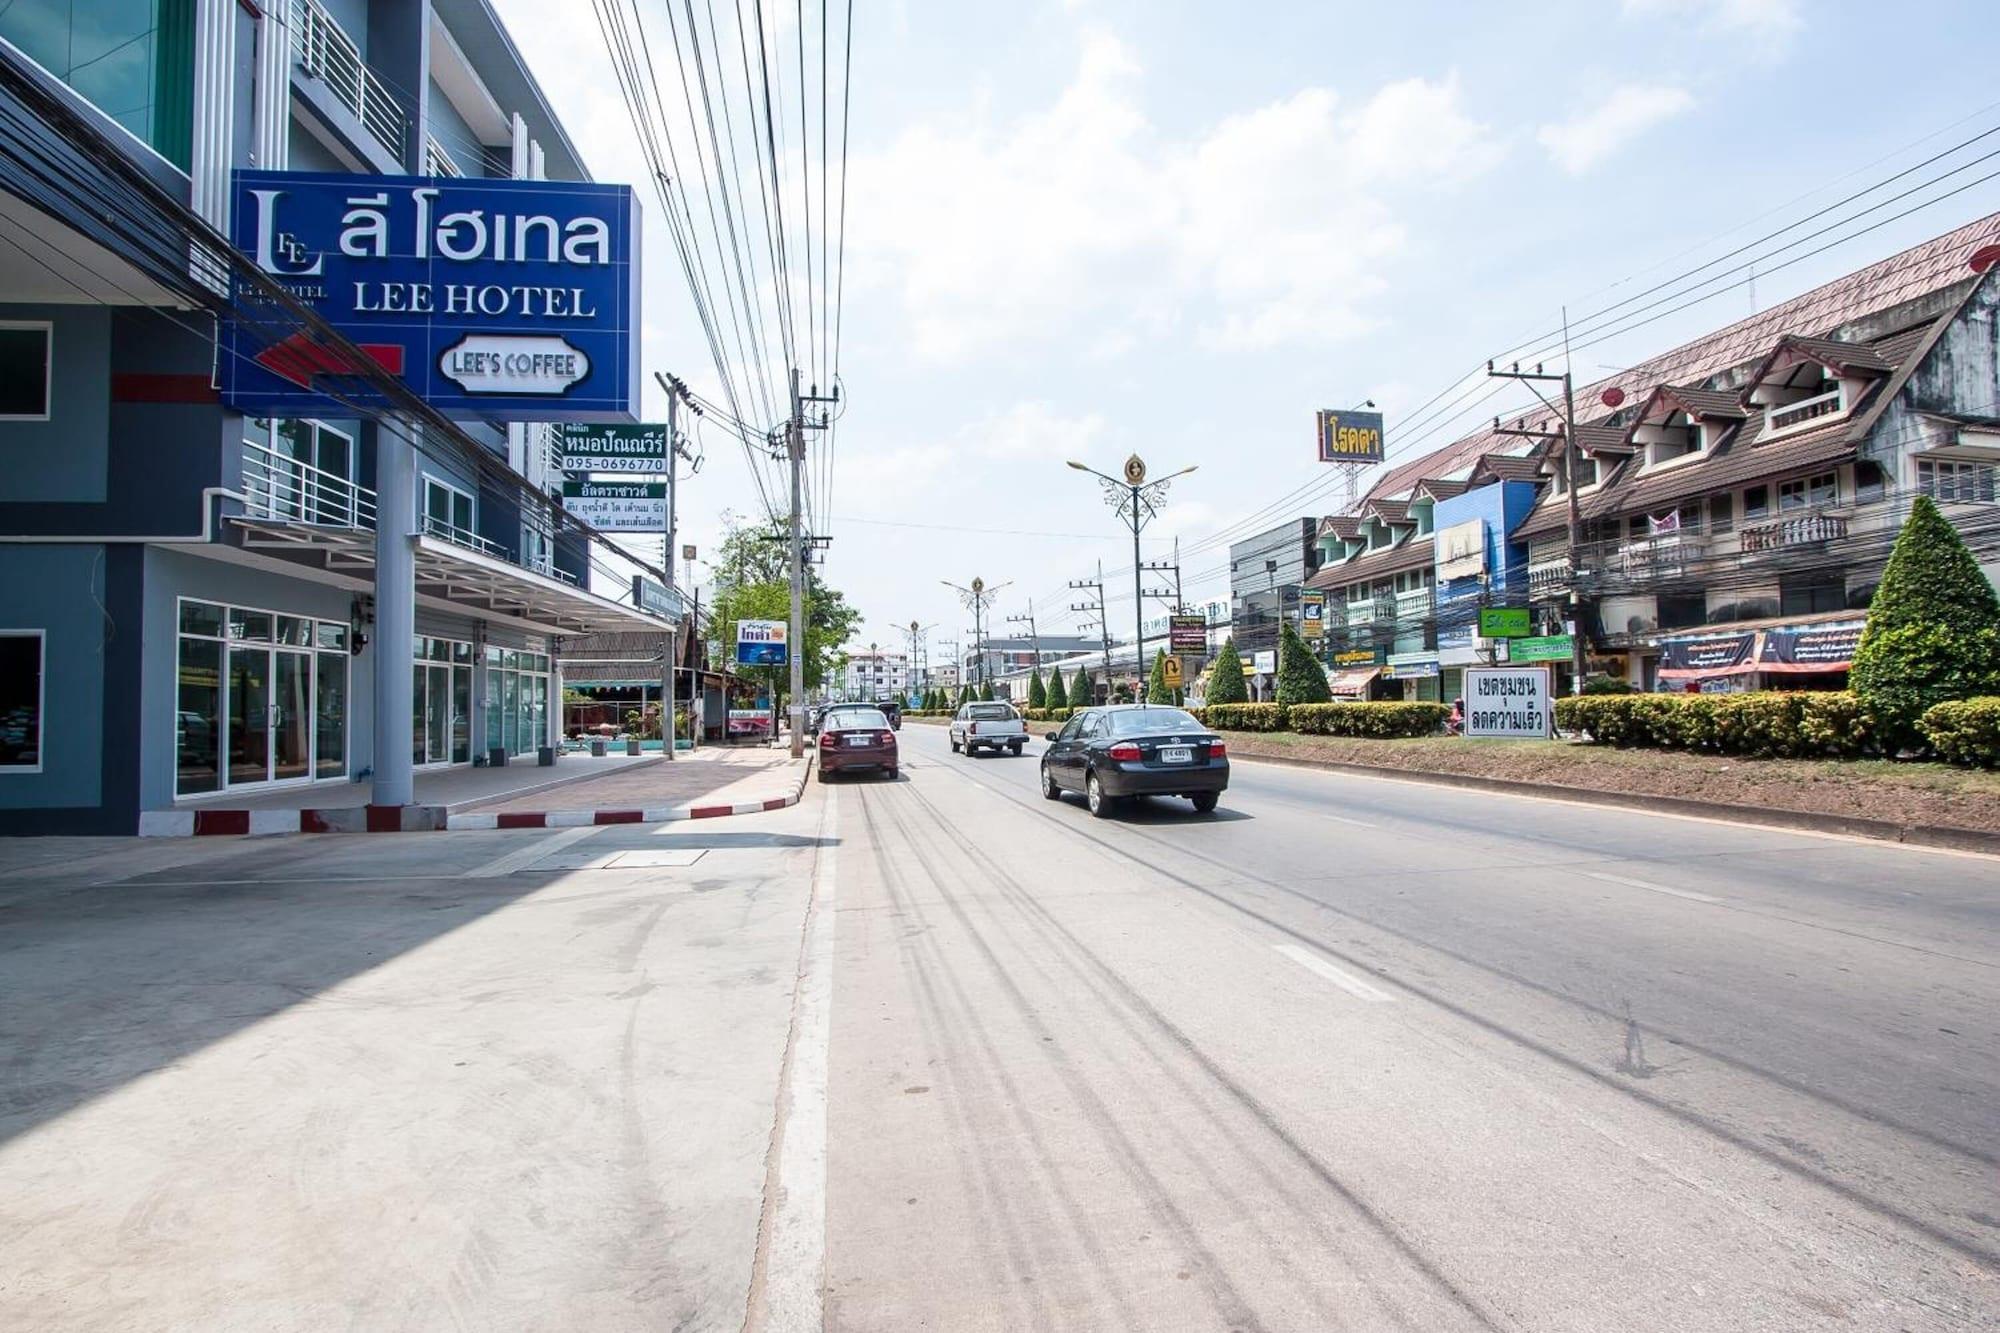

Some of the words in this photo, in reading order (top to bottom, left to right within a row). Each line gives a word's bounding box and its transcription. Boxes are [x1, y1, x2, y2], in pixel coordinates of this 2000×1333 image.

[339, 192, 388, 257] ลี
[412, 188, 609, 264] โฮเทล
[353, 281, 434, 313] LEE
[445, 283, 596, 318] HOTEL
[452, 351, 501, 377] LEE'S
[504, 352, 576, 378] COFFEE
[566, 458, 663, 470] 095-0696770
[1478, 677, 1536, 707] เขตชุมชน
[1472, 701, 1542, 730] ลดความเร็ว
